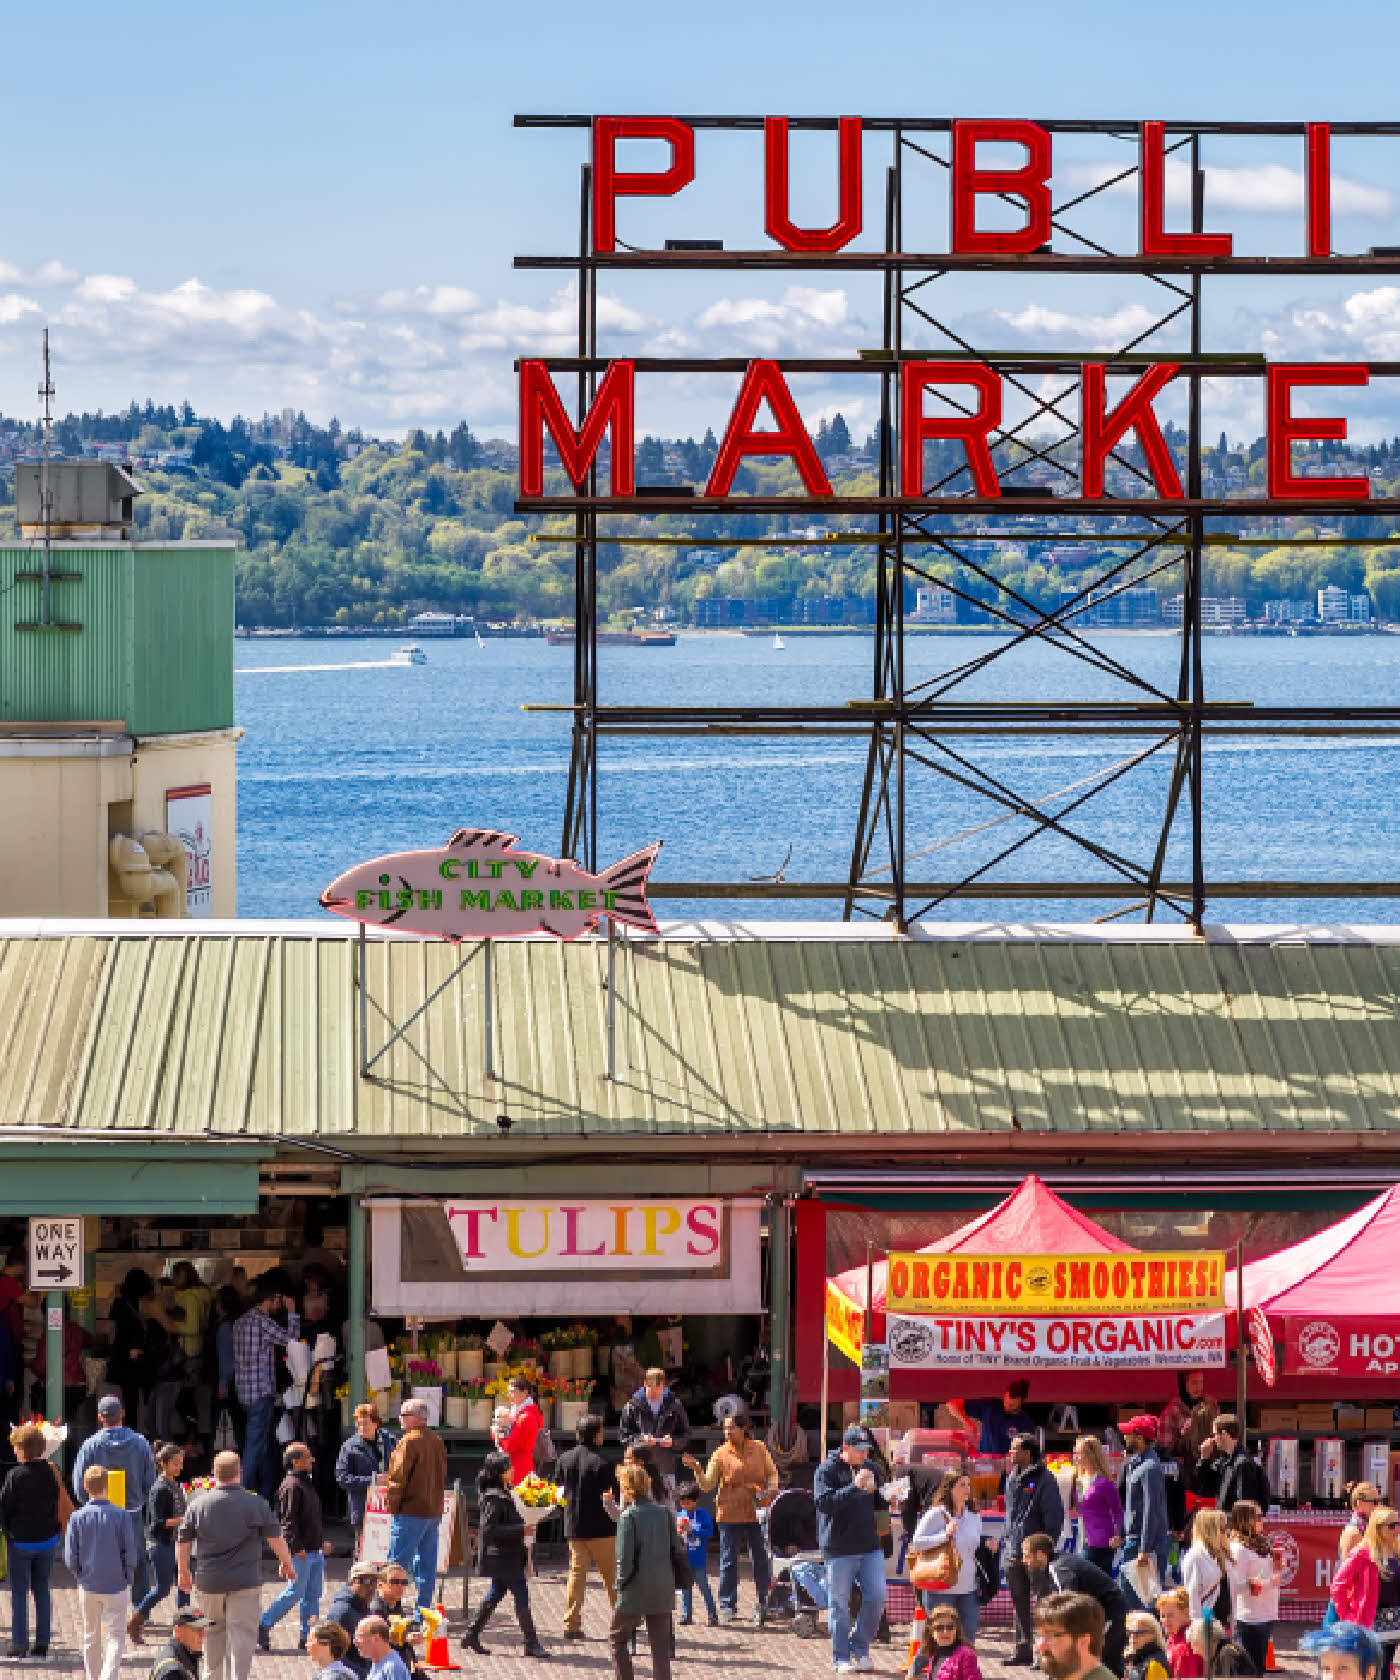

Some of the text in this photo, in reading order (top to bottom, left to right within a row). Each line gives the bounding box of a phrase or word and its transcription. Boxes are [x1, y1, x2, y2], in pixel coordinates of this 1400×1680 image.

[438, 858, 540, 880] CITY
[356, 889, 621, 912] FISH MARKET
[36, 1223, 75, 1241] ONE
[449, 1205, 720, 1258] TULIPS
[36, 1243, 77, 1260] WAY
[892, 1259, 1218, 1299] ORGANIC SMOOTHIES!
[934, 1319, 1037, 1353] TINY'S
